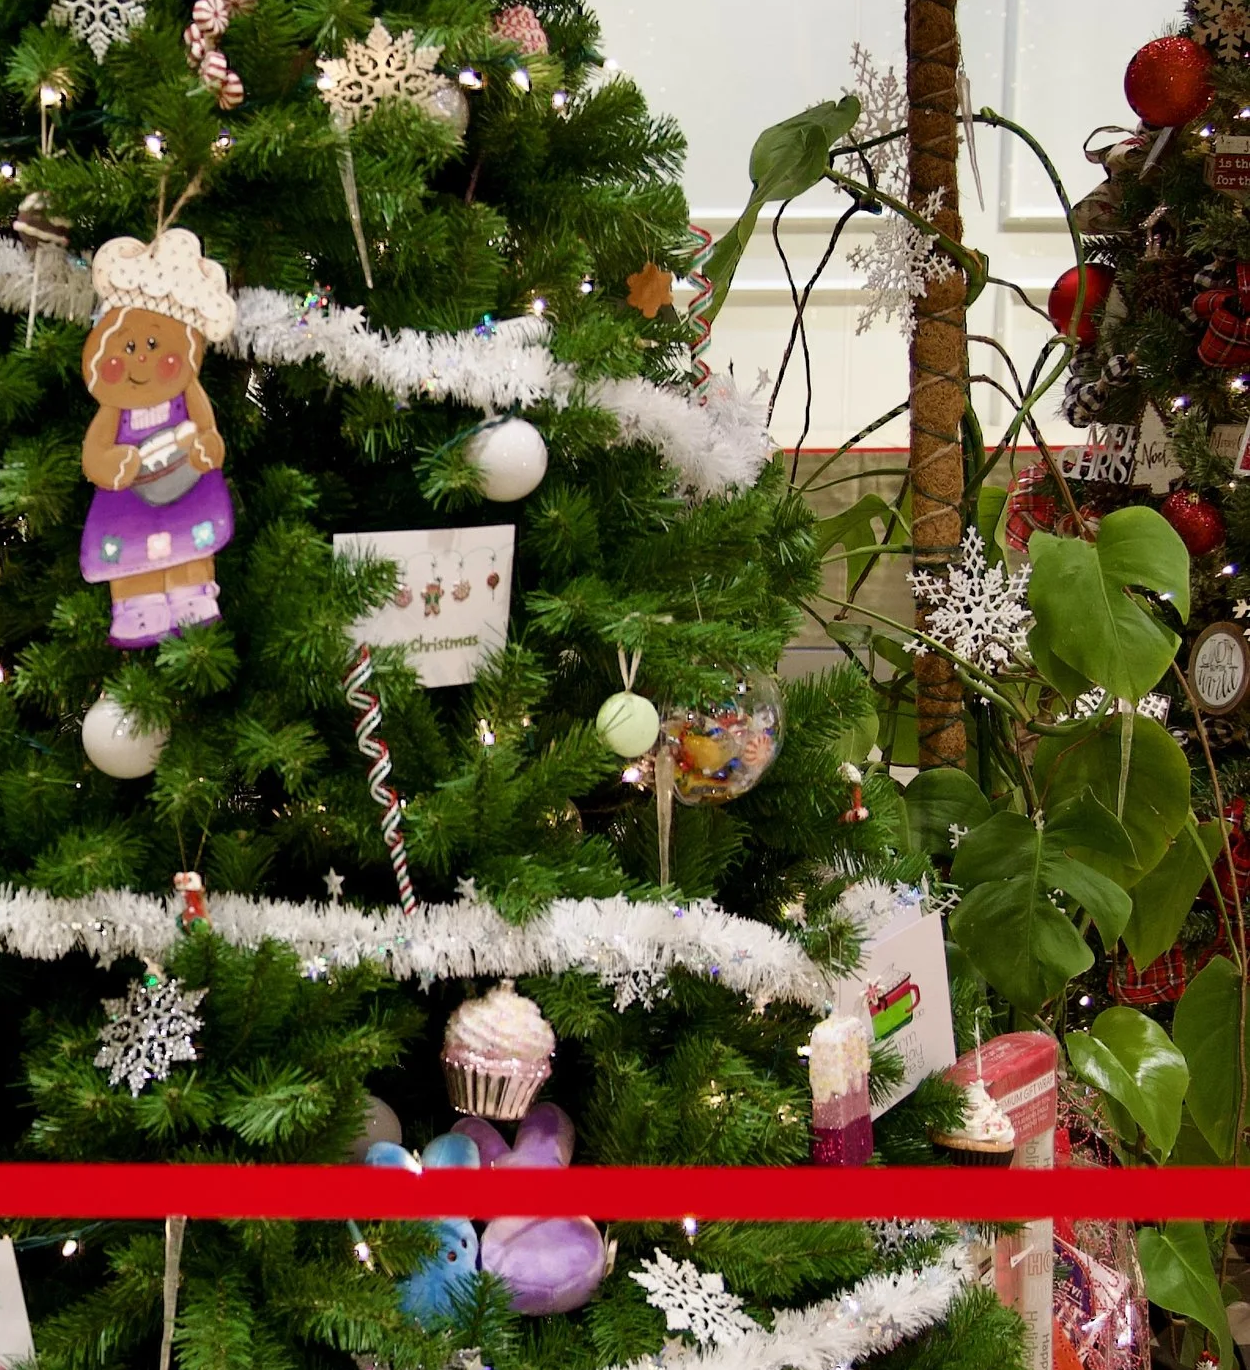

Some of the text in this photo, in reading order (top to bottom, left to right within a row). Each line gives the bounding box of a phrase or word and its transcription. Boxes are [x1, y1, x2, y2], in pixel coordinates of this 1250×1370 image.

[1218, 158, 1232, 169] is
[1216, 174, 1236, 186] for
[410, 633, 479, 653] Christmas
